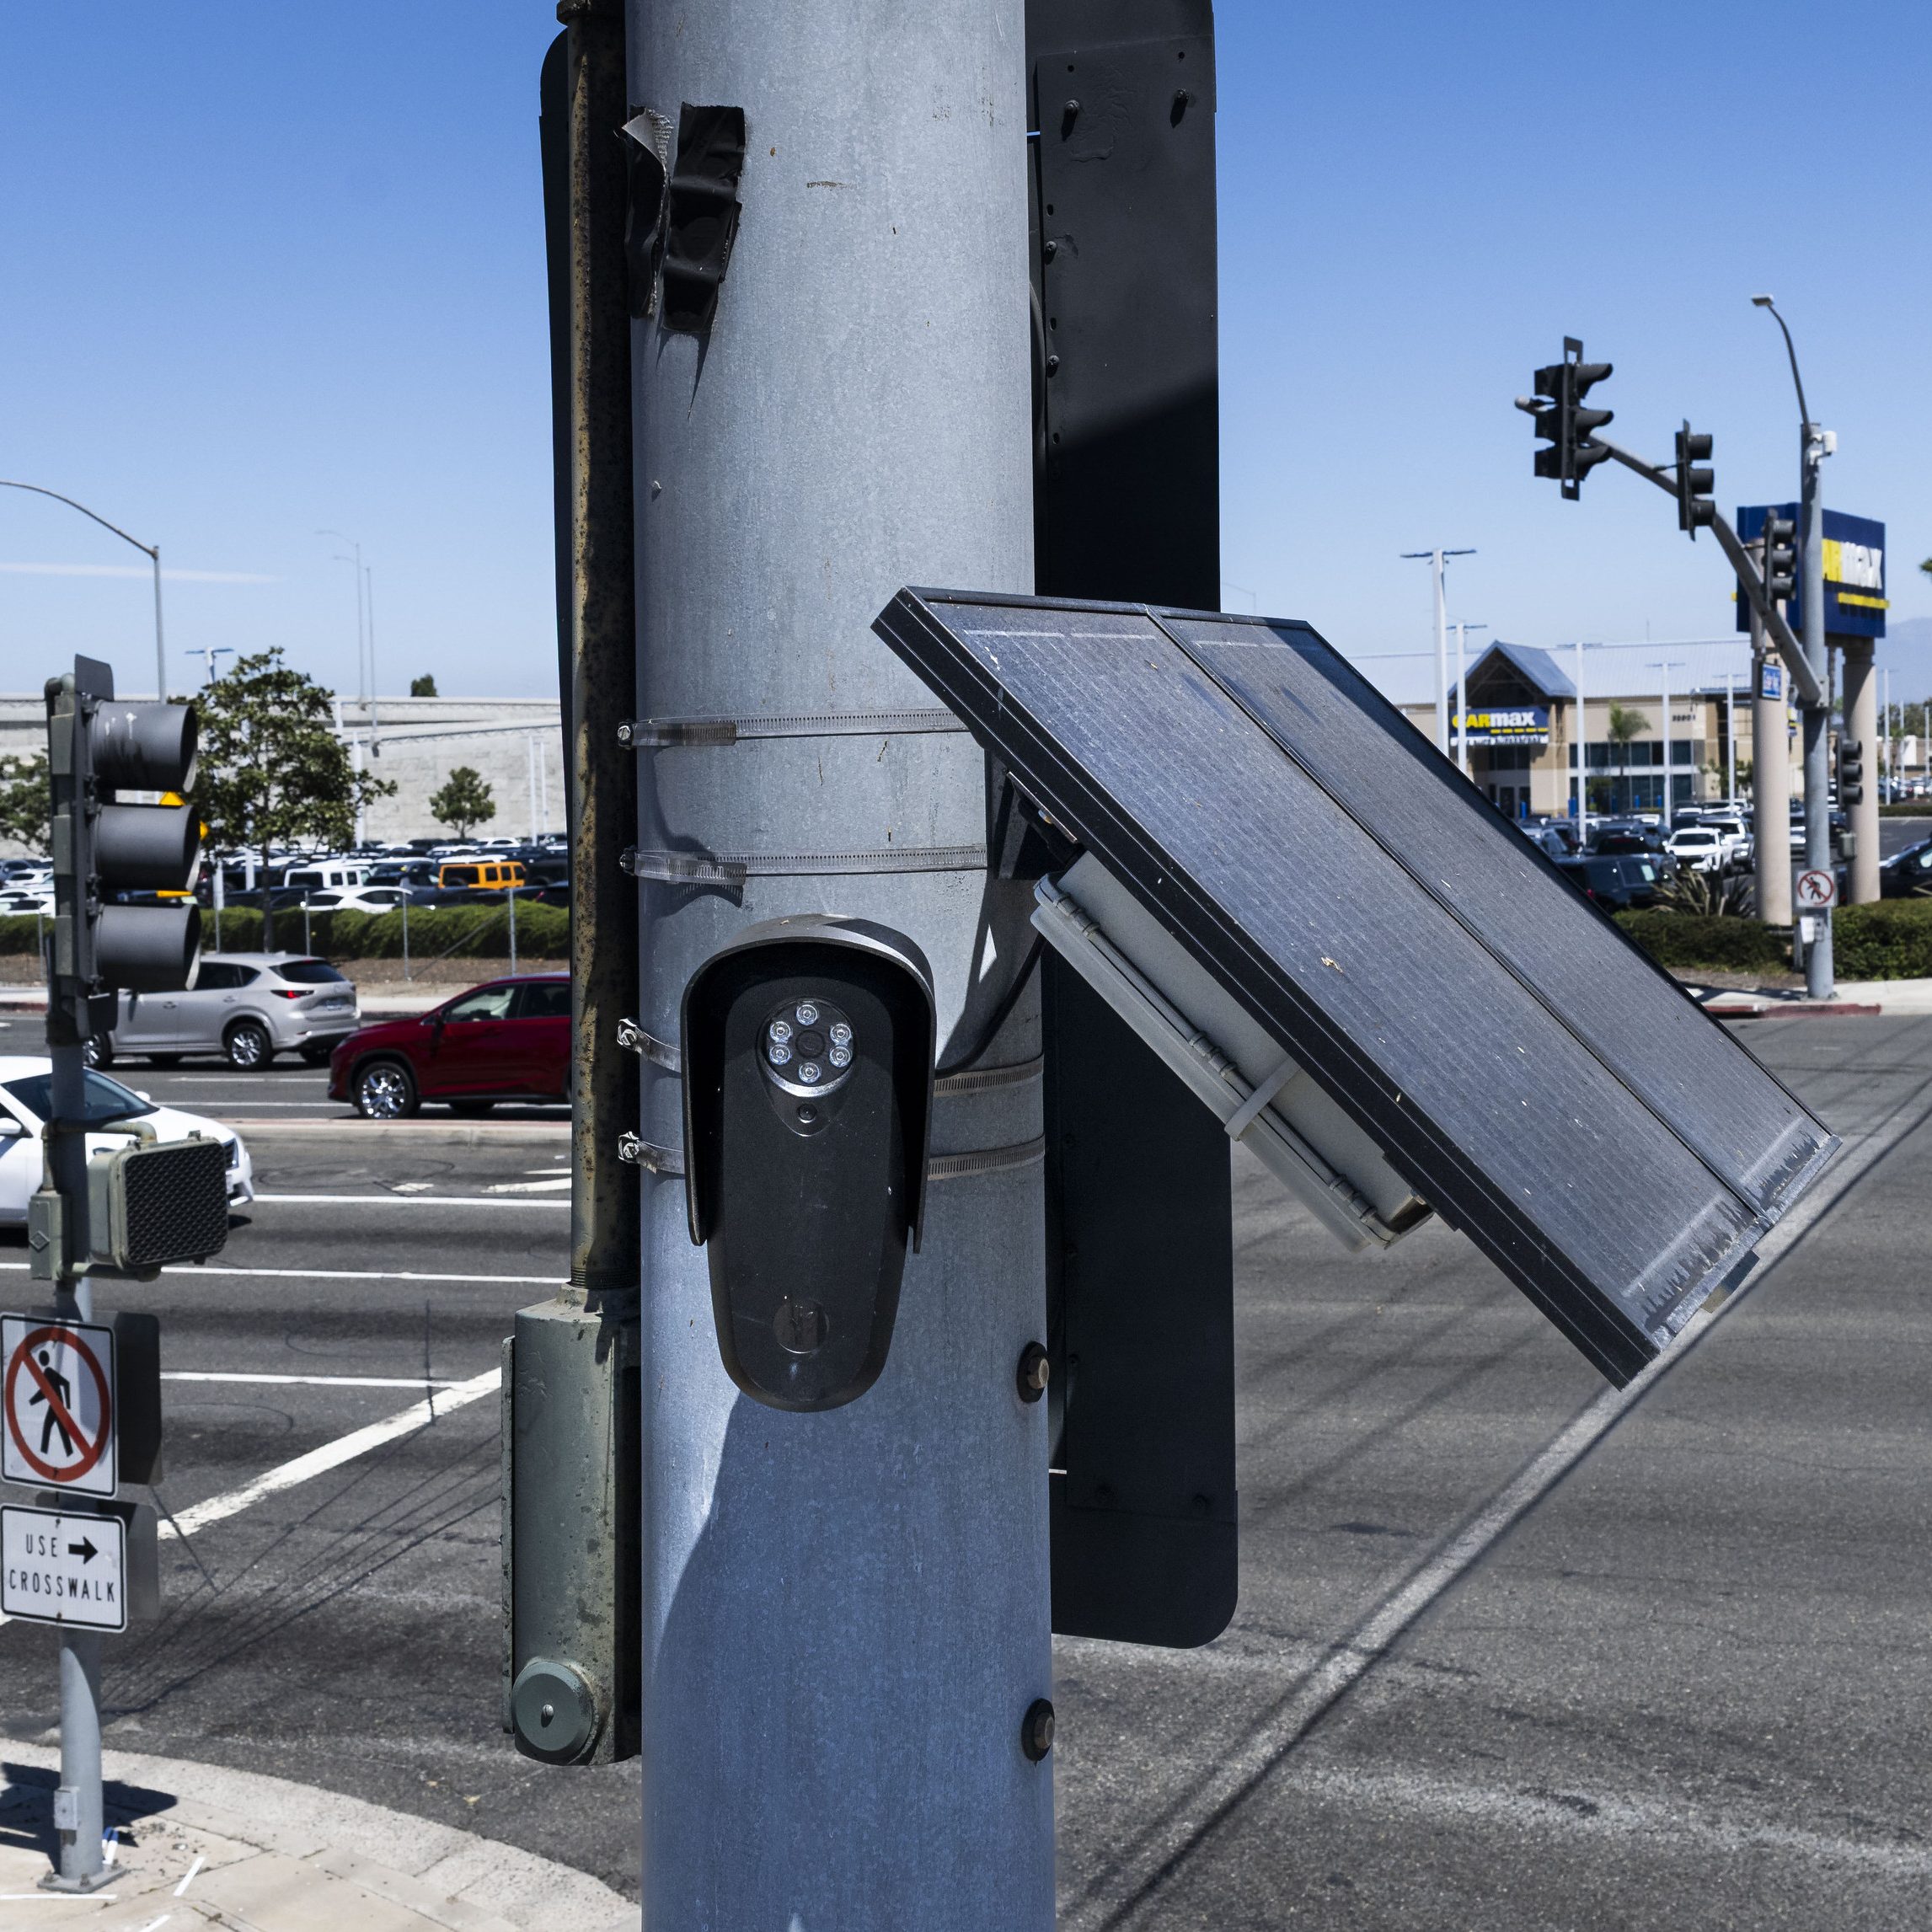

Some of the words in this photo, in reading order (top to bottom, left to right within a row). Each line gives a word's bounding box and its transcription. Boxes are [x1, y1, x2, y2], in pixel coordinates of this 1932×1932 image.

[1822, 538, 1882, 590] ARmax
[26, 1533, 57, 1558] USE
[9, 1569, 115, 1603] CROSSWALK
